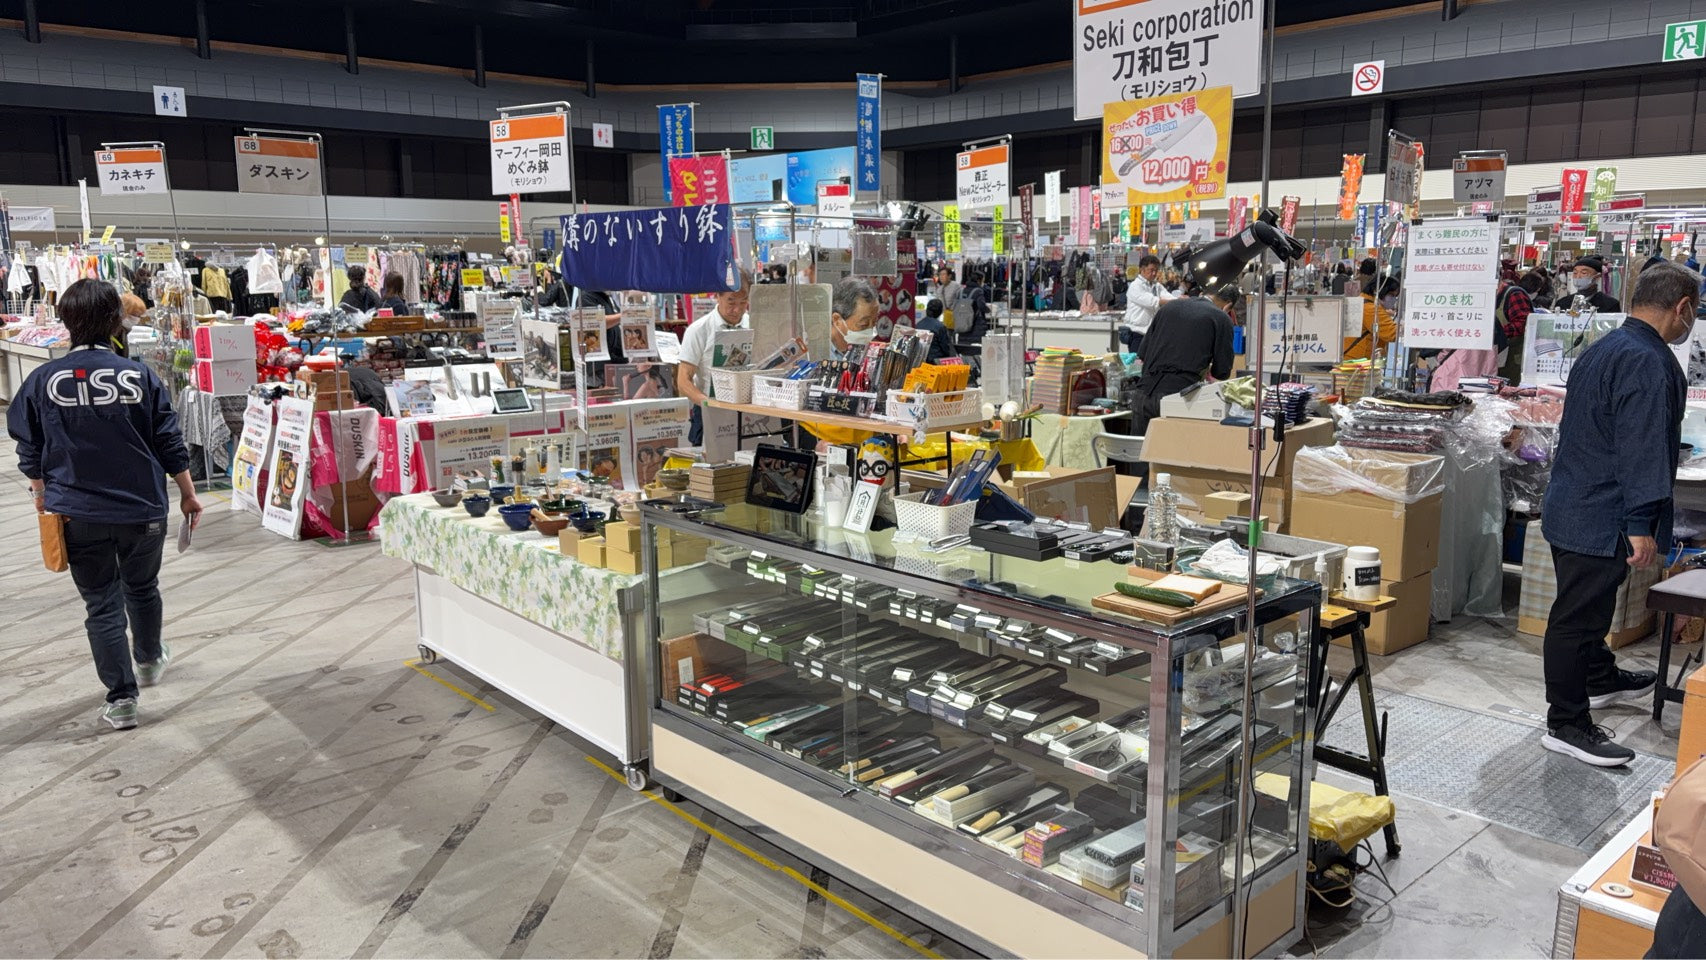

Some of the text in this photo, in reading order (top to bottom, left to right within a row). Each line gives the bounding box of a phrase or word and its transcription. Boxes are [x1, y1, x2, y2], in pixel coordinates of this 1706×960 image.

[1083, 0, 1253, 52] Seki corporation
[1112, 34, 1220, 81] 刀和包丁
[1121, 72, 1207, 101] （モリショウ）
[1136, 96, 1197, 126] お買い得
[496, 125, 507, 137] 58
[243, 141, 256, 151] 68
[495, 142, 562, 159] マーフィー岡田
[109, 169, 155, 181] カネキチ
[249, 164, 309, 181] ダスキン
[507, 159, 549, 175] めぐみ鉢
[1142, 156, 1208, 185] 12,000 円
[561, 203, 724, 252] 溝のないすり鉢
[1417, 228, 1488, 239] まくら難民の方に
[1423, 293, 1474, 306] ひのき枕
[1412, 311, 1483, 321] 肩こり・首こりに
[1411, 328, 1482, 338] 洗って永く使える
[349, 417, 366, 459] DUSKIN
